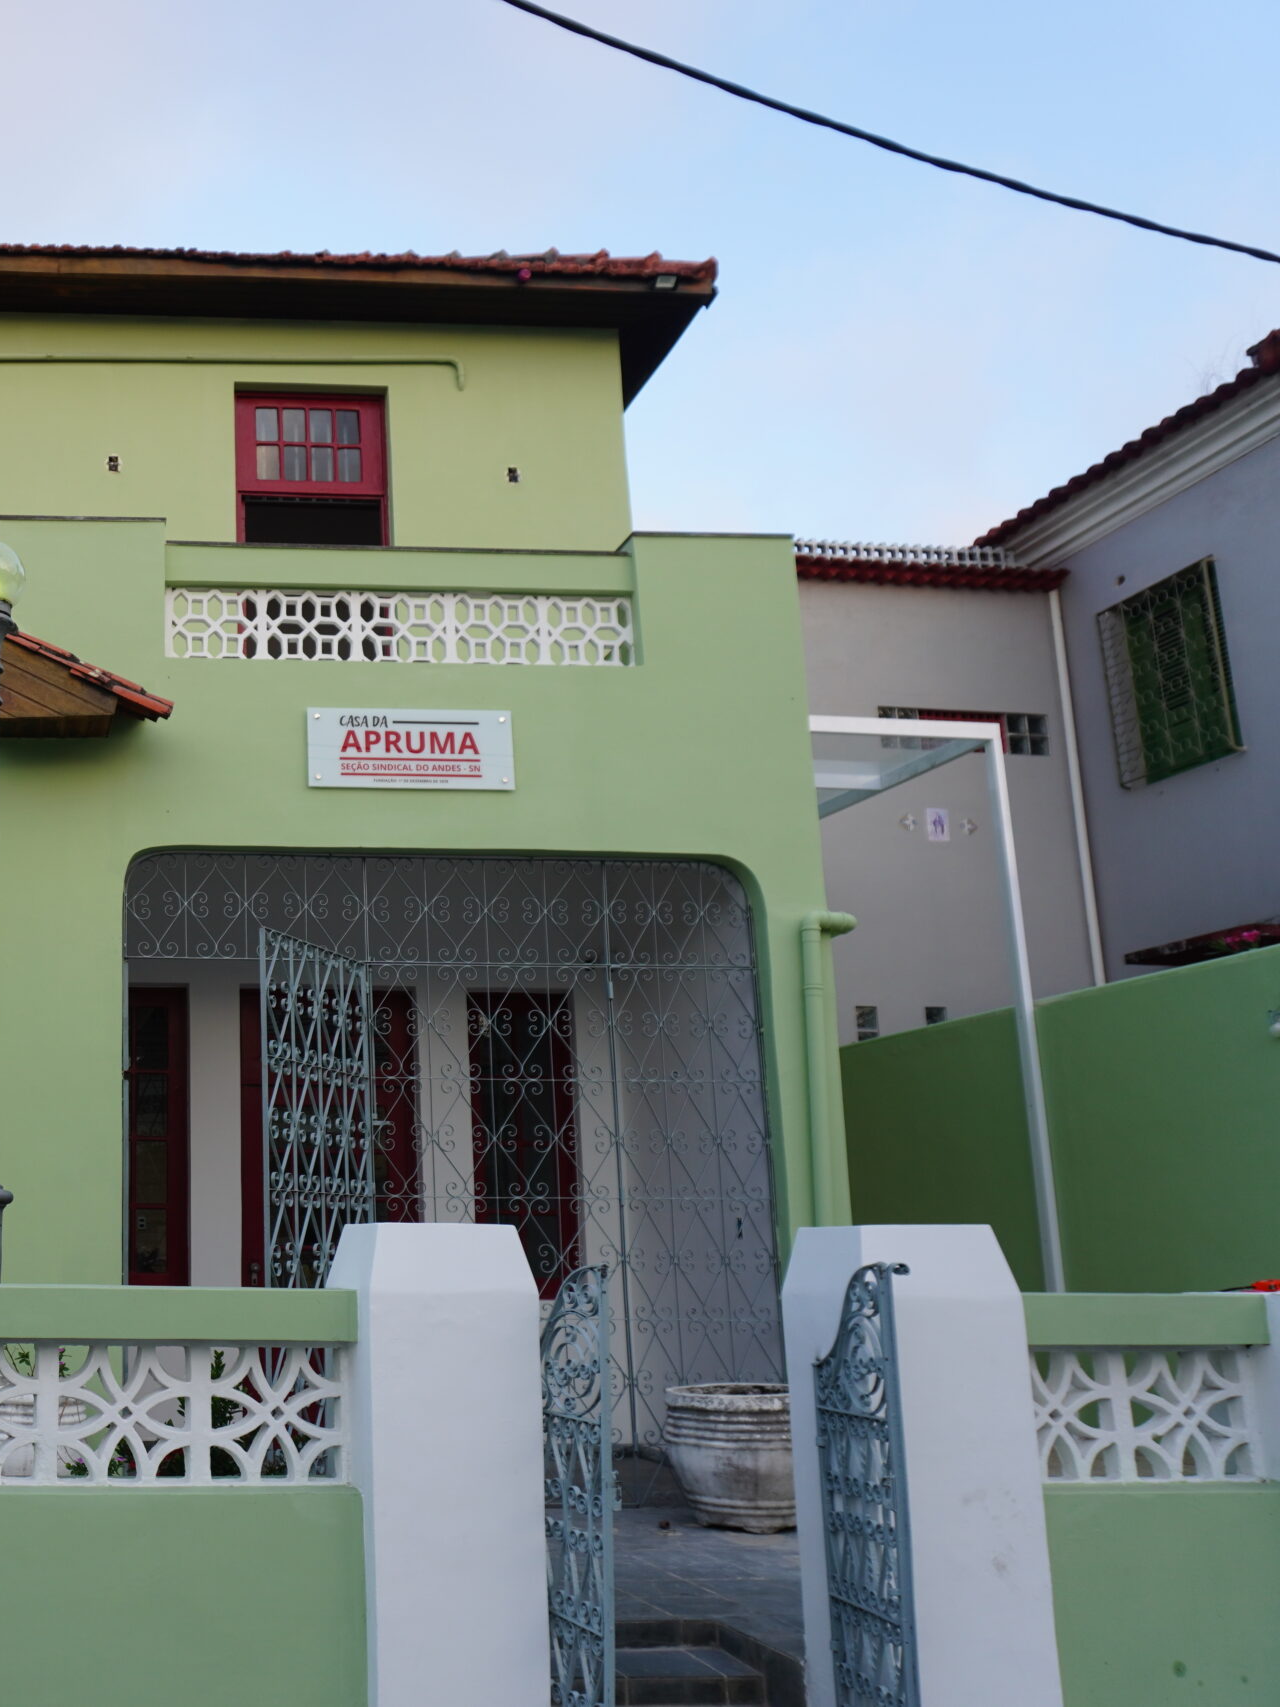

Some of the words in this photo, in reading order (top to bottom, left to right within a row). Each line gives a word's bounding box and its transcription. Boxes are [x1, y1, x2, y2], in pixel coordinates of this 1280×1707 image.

[340, 715, 369, 728] CASA
[372, 715, 388, 728] DA
[340, 730, 480, 754] APRUMA
[341, 761, 370, 772] SEÇÃO
[372, 763, 413, 772] SINDICAL
[416, 764, 429, 772] DO
[432, 764, 462, 772] ANDES
